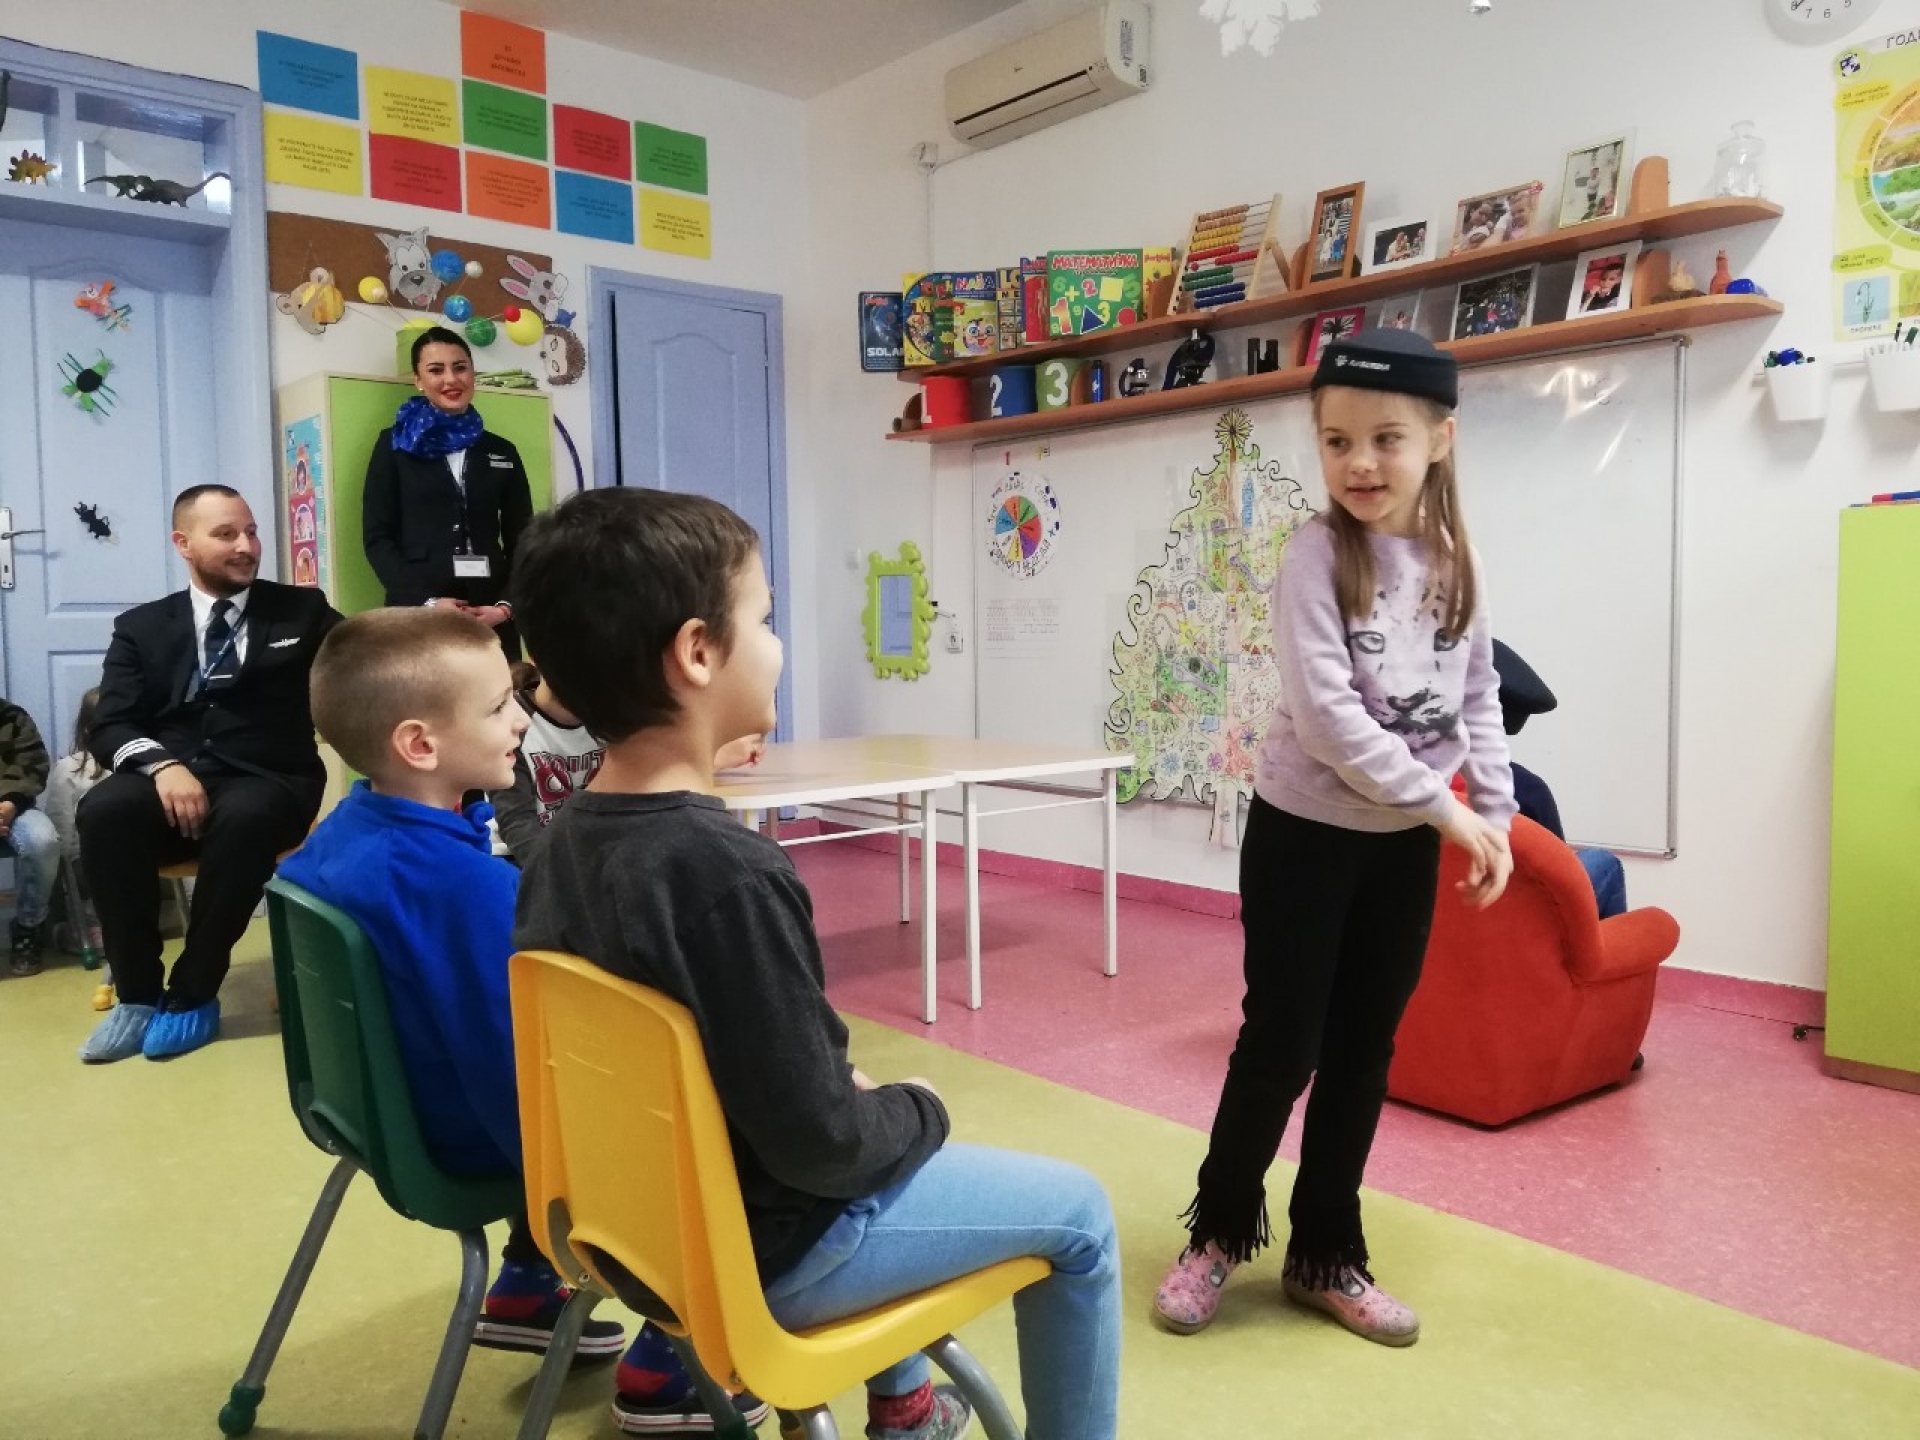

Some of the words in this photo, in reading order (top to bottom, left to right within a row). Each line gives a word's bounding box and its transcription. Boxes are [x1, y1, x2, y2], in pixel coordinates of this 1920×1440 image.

[1805, 8, 1813, 19] 7
[1823, 8, 1831, 19] 6
[1081, 278, 1098, 298] 2
[1050, 297, 1073, 334] 1
[1097, 301, 1111, 324] 3
[989, 374, 1003, 418] 2
[1044, 362, 1069, 407] 3
[920, 385, 933, 424] 1
